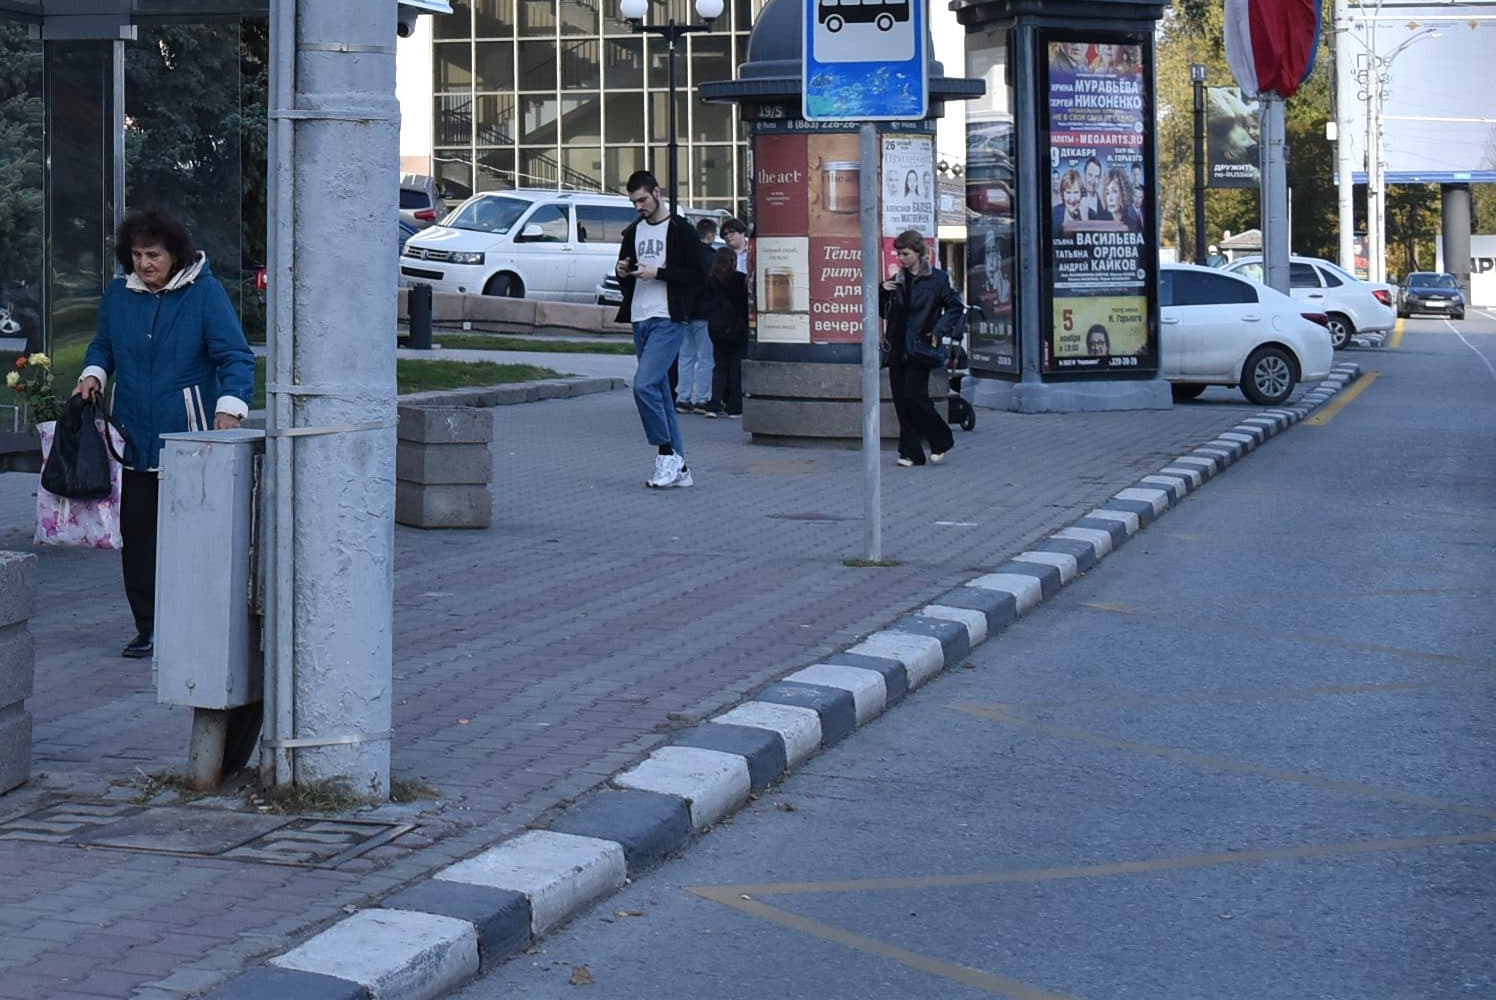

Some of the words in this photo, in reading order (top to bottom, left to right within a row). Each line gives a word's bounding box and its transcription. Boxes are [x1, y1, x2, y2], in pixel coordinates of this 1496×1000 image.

[1075, 78, 1139, 94] МУРАВЬЁВА
[1075, 95, 1142, 109] НИКОНЕНКО
[759, 105, 783, 118] 19/5
[885, 141, 896, 151] 26
[1079, 134, 1144, 144] MEGAARTS.RU
[1061, 149, 1096, 158] ДЕКАБРЯ
[758, 168, 776, 185] the
[1076, 232, 1145, 246] ВАСИЛЬЕВА
[638, 239, 664, 257] GAP
[1056, 250, 1089, 258] ТАТЬЯНА
[1093, 246, 1139, 258] ОРЛОВА
[1058, 262, 1089, 272] АНДРЕЙ
[1091, 258, 1137, 271] КАЙКОВ
[821, 267, 862, 281] риту
[834, 285, 862, 297] для
[1062, 308, 1073, 331] 5
